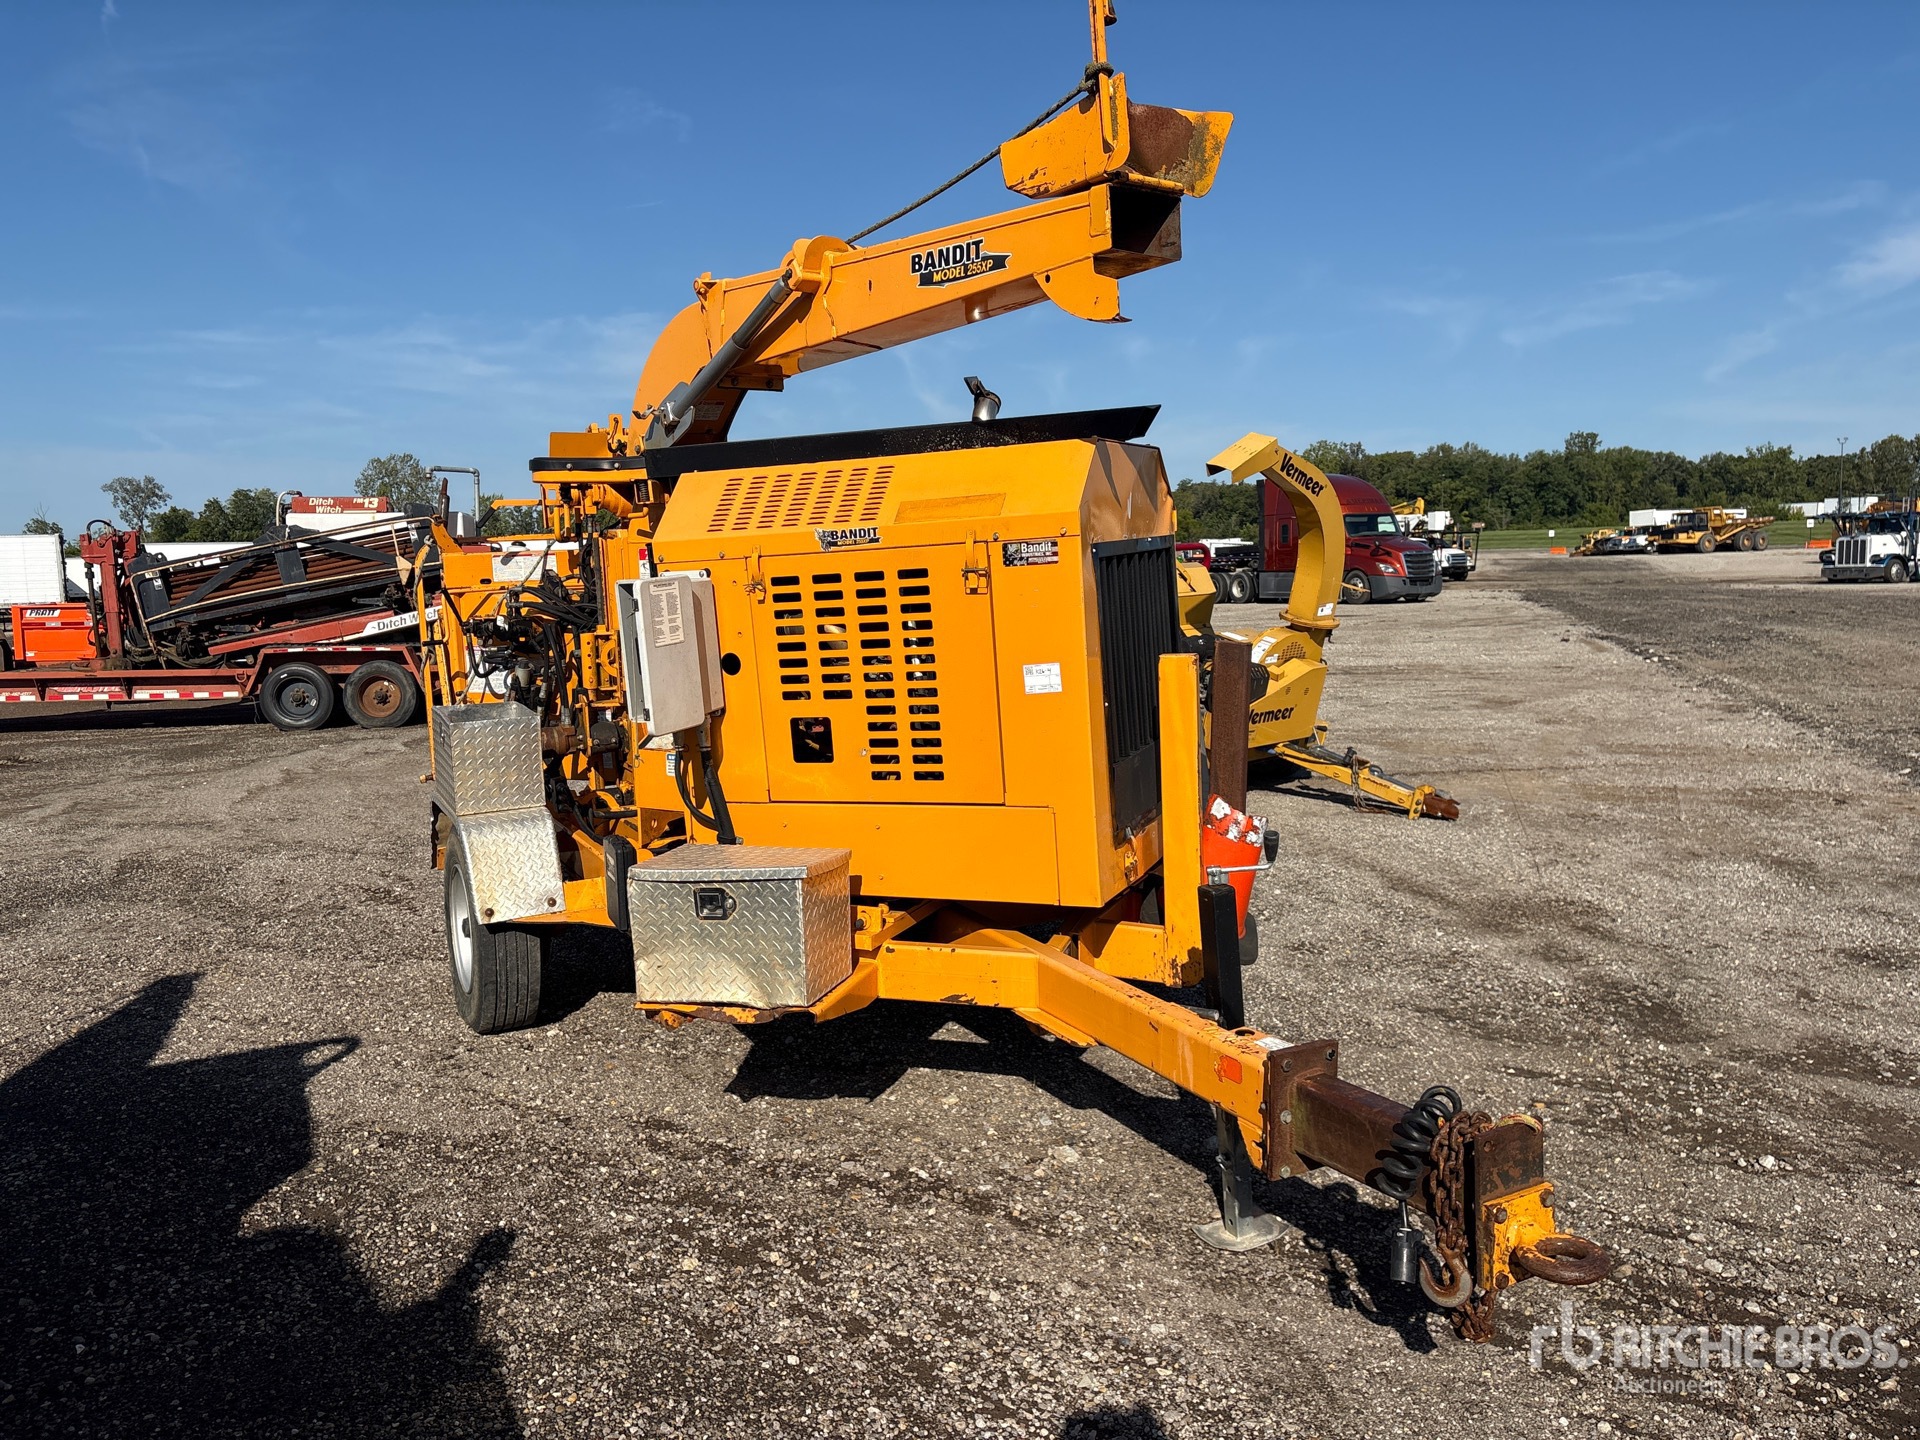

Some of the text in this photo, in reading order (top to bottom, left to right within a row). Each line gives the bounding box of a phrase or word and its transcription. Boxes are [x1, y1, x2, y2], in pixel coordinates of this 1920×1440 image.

[910, 237, 984, 275] BANDIT
[933, 259, 994, 283] MODEL 255XP
[1279, 452, 1325, 498] Vermeer
[308, 497, 334, 506] Ditch
[315, 505, 342, 514] Witch
[830, 526, 879, 541] BANDIT
[1021, 541, 1052, 553] Bandit
[377, 616, 407, 631] Ditch
